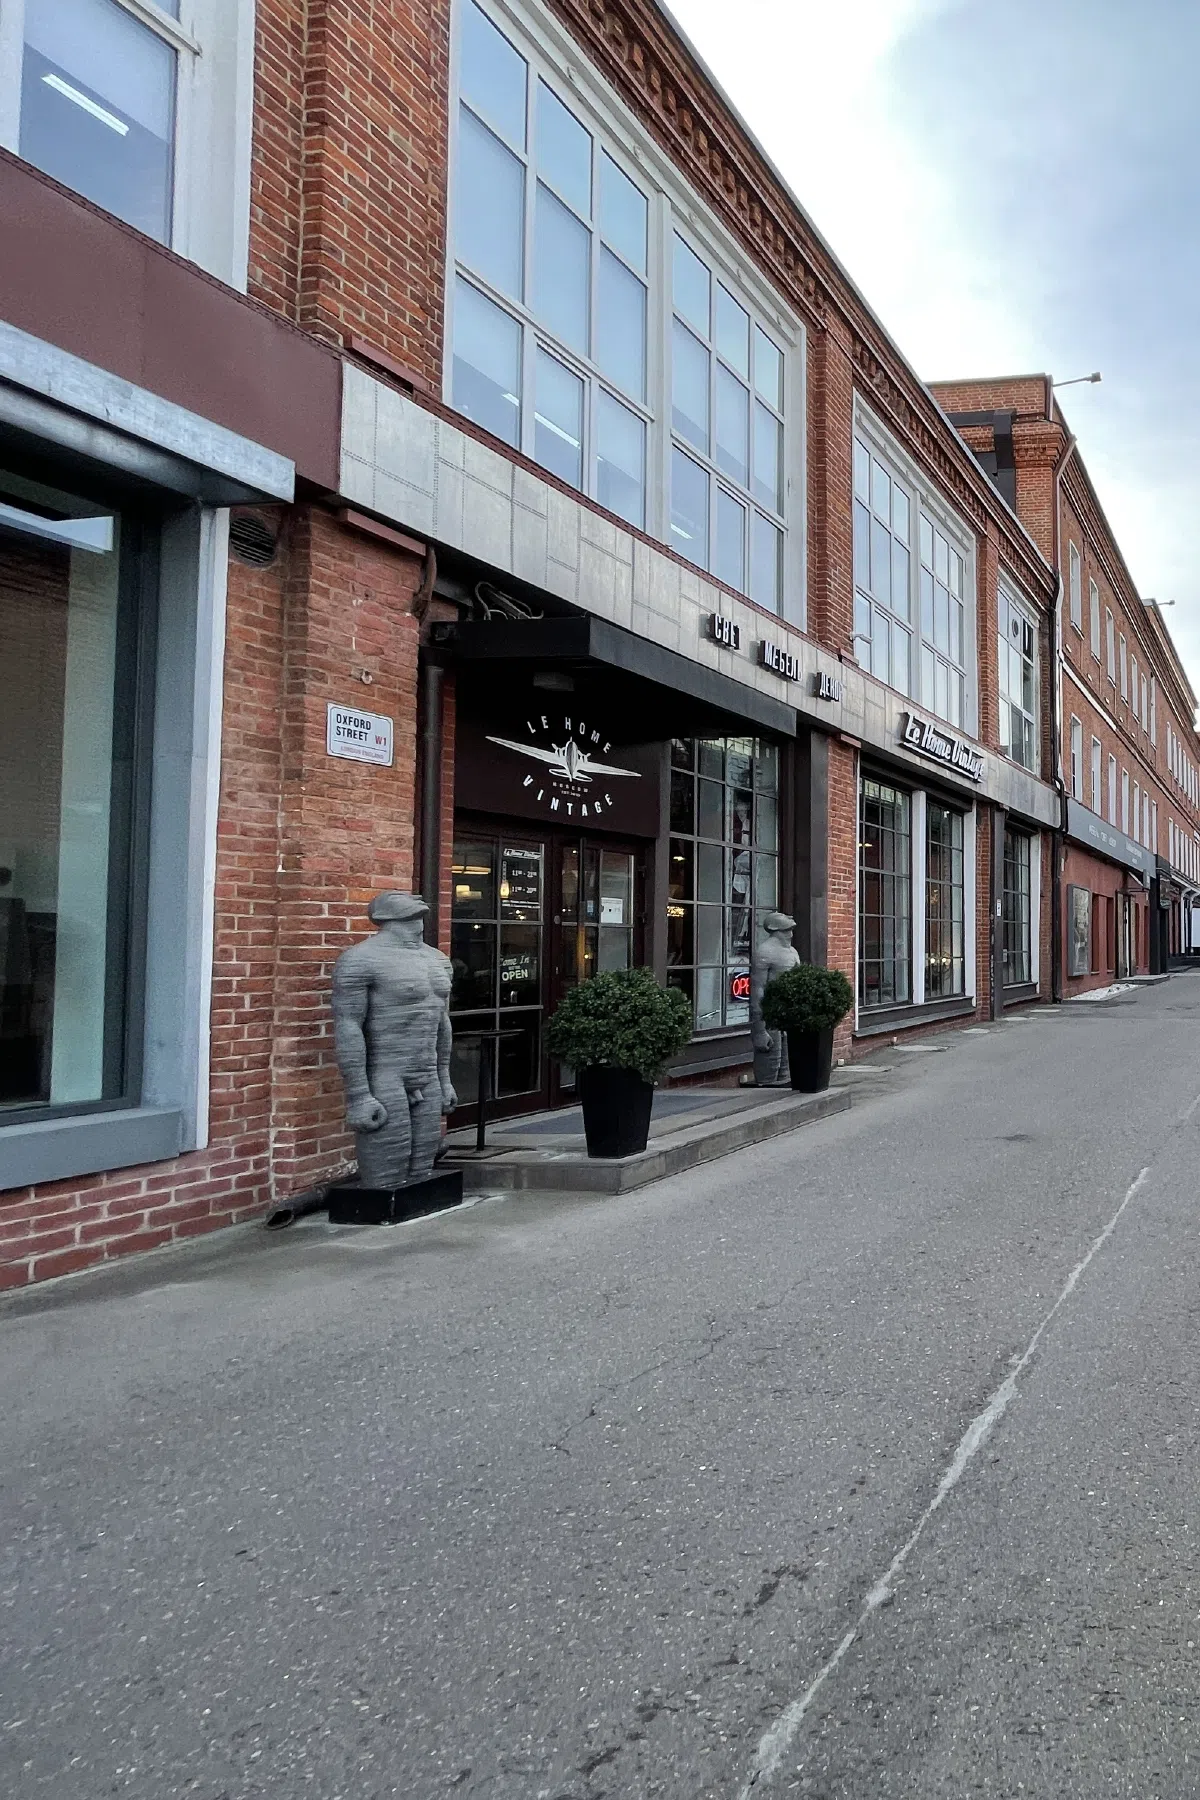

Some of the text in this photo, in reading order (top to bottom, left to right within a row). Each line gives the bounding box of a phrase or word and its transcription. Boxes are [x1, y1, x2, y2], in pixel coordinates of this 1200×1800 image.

[762, 640, 803, 682] МЕБЕЛЬ
[335, 726, 387, 746] STREET W1
[336, 713, 371, 731] OXFORD
[527, 715, 612, 753] LE HOME
[904, 713, 985, 779] Le Home Vintage
[522, 774, 613, 817] VINTAGE
[501, 968, 529, 981] OPEN
[732, 977, 750, 996] OPE
